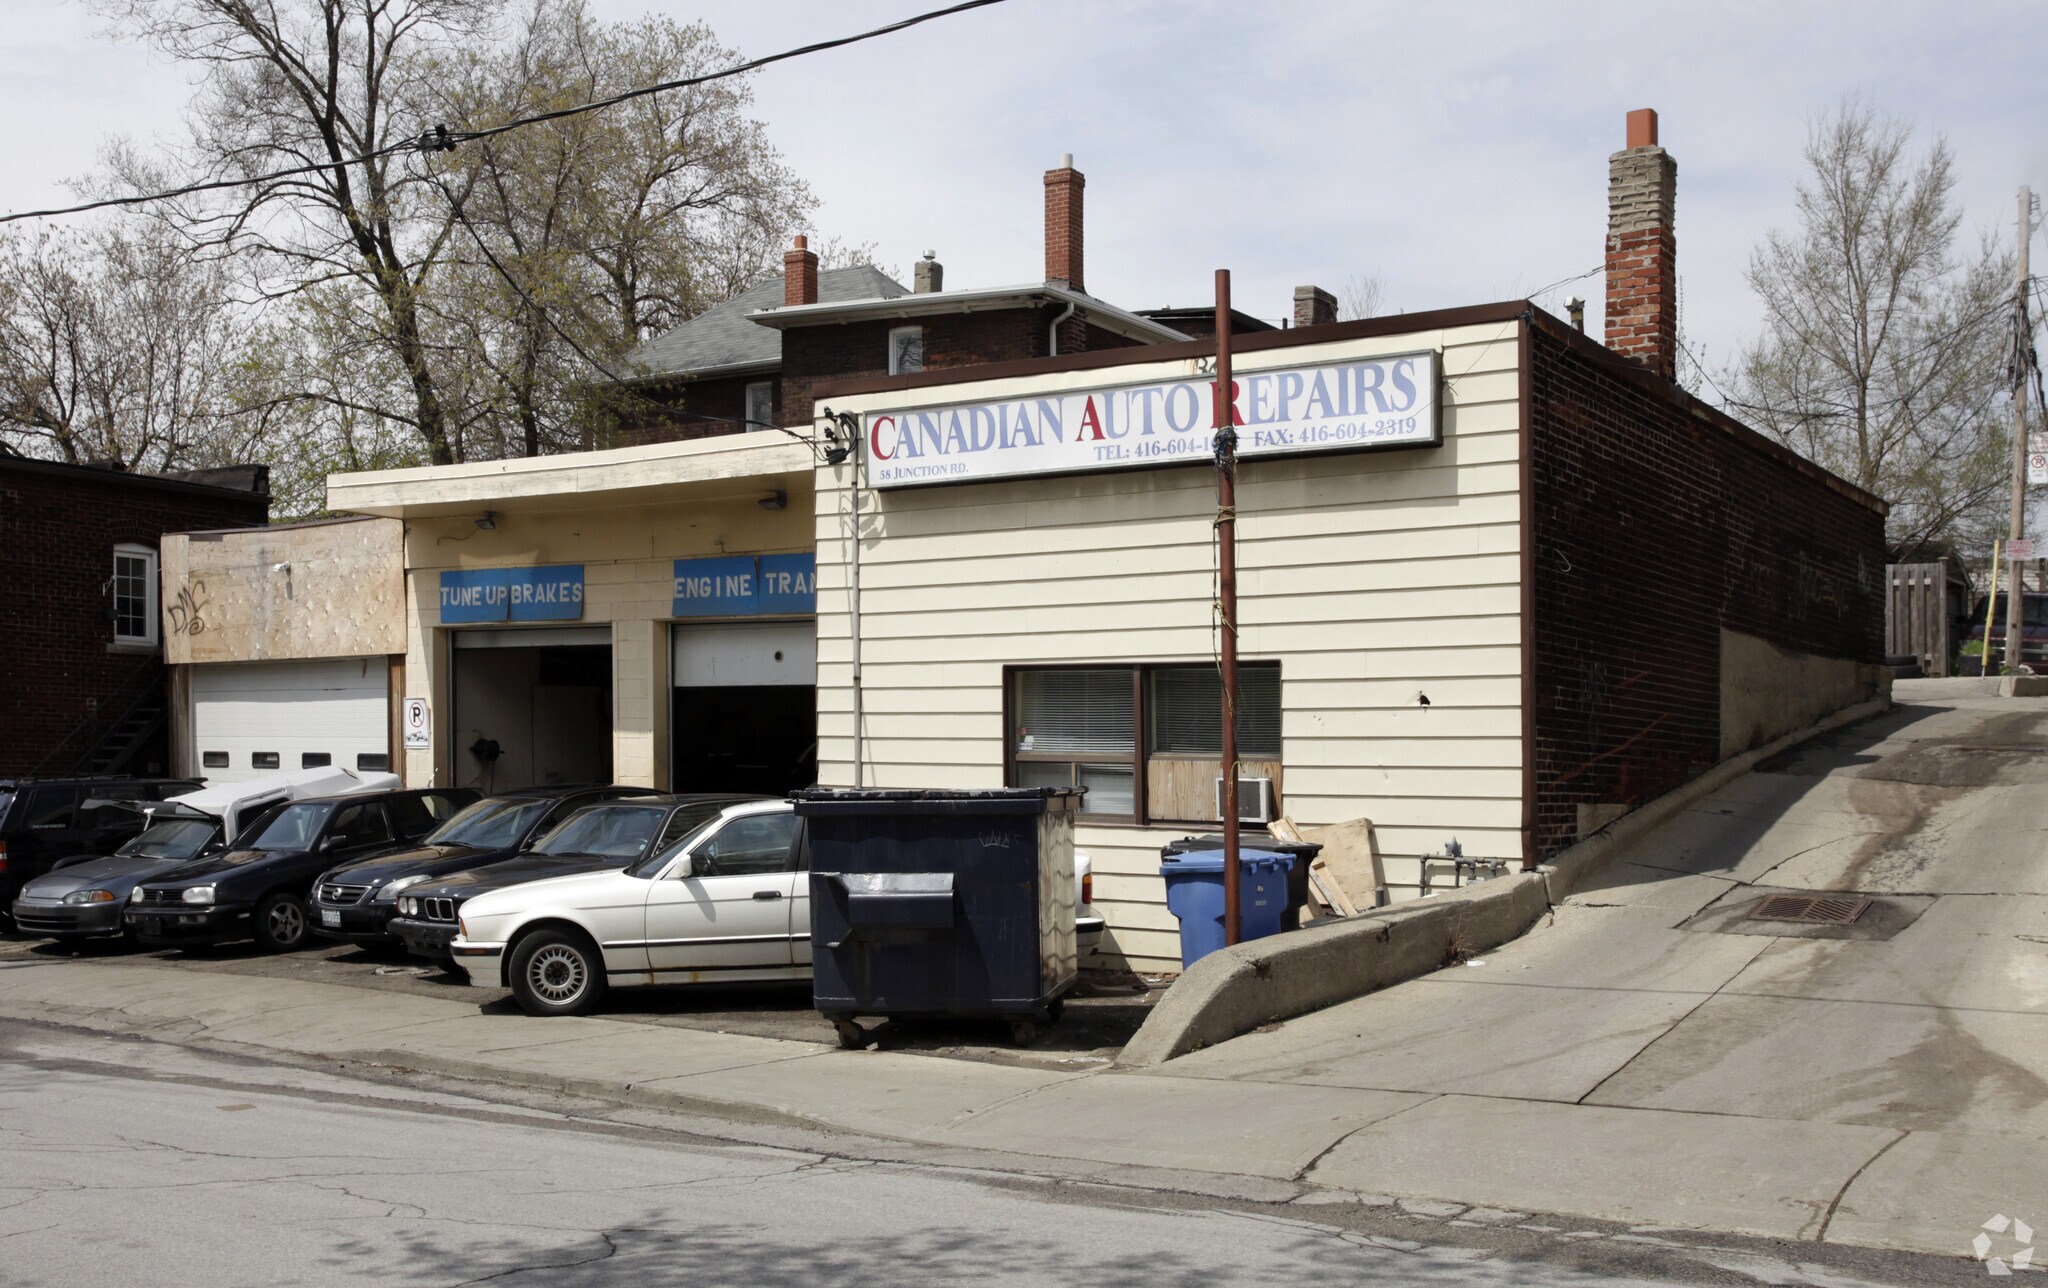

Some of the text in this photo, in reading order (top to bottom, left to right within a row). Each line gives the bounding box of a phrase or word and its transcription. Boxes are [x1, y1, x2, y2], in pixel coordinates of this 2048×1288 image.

[870, 358, 1417, 461] CANADIAN AUTO REPAIRS
[1254, 416, 1417, 447] FAX: 416-604-2319
[1093, 436, 1240, 462] TEL: 416-604-1
[879, 462, 969, 480] 58 JUNCTION RD.
[440, 582, 583, 607] TUNE UP BRAKES
[674, 574, 752, 599] ENGINE
